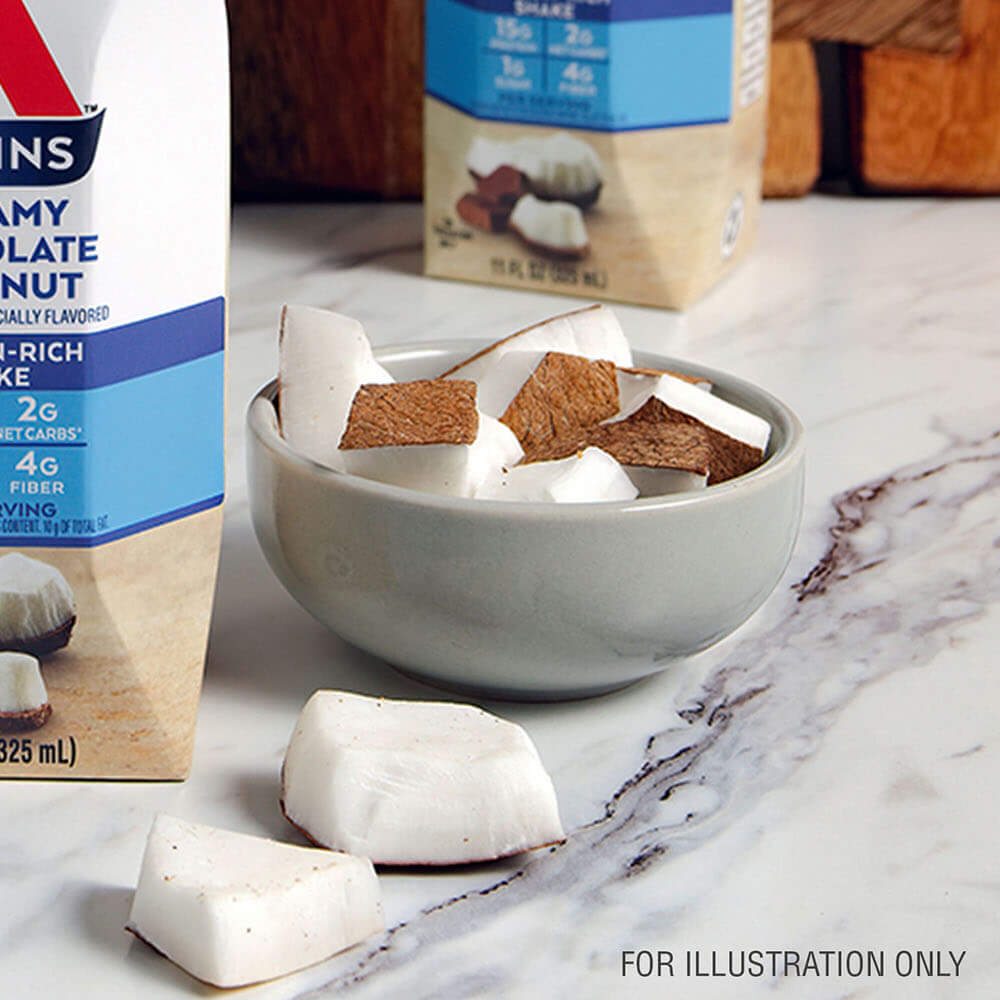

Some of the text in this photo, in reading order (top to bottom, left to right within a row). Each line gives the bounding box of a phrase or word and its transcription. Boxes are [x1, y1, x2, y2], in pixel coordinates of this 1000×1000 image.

[45, 305, 109, 325] FLAVORED
[17, 396, 58, 421] 2G
[15, 450, 58, 476] 4G
[10, 482, 64, 494] FIBER
[39, 736, 77, 767] mL)
